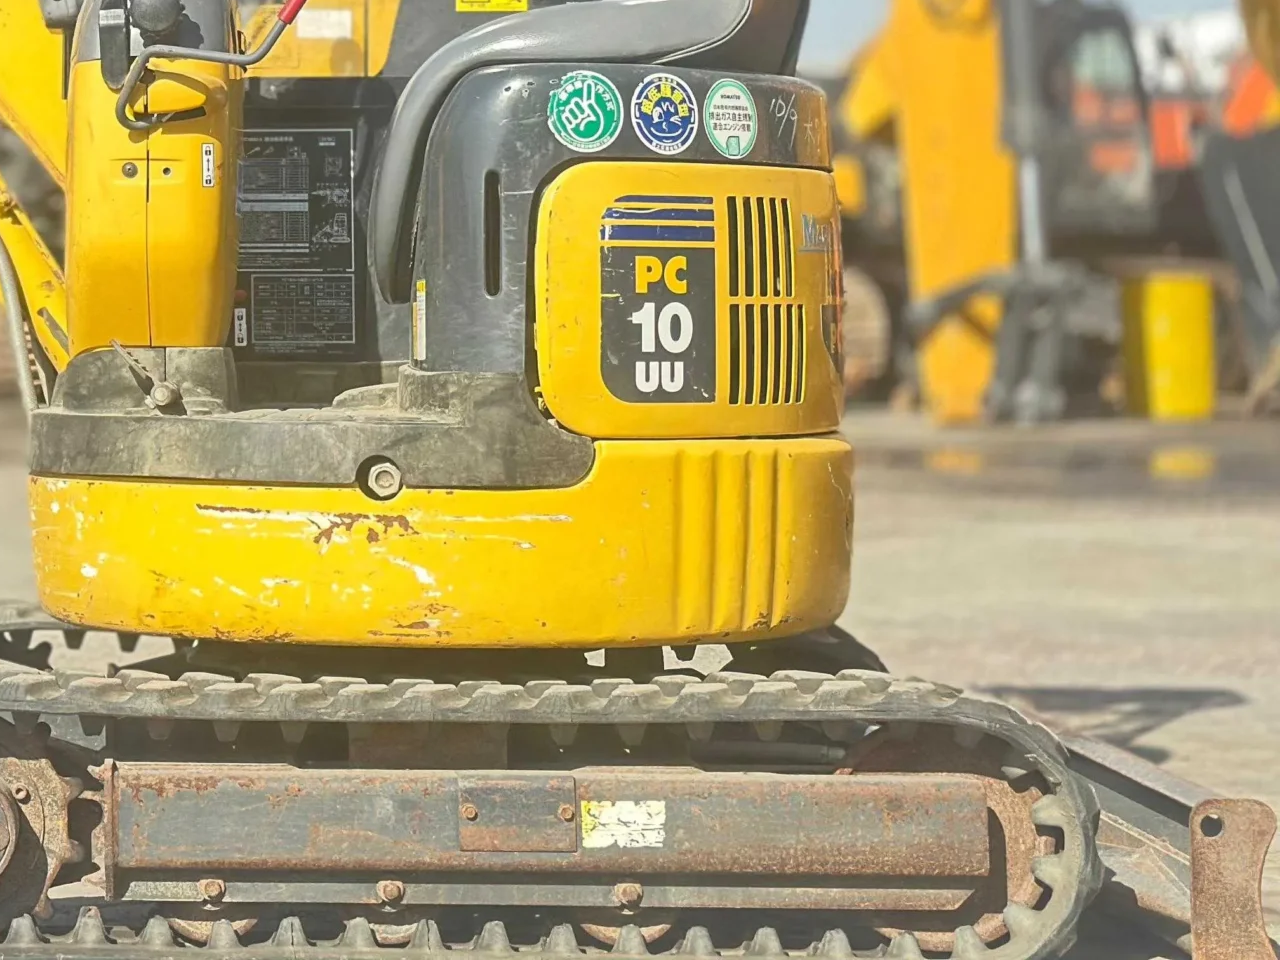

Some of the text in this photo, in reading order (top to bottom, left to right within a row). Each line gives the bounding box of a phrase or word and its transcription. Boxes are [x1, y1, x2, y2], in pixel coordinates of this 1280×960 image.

[635, 255, 688, 294] PC
[631, 302, 694, 354] 10
[635, 361, 685, 392] UU
